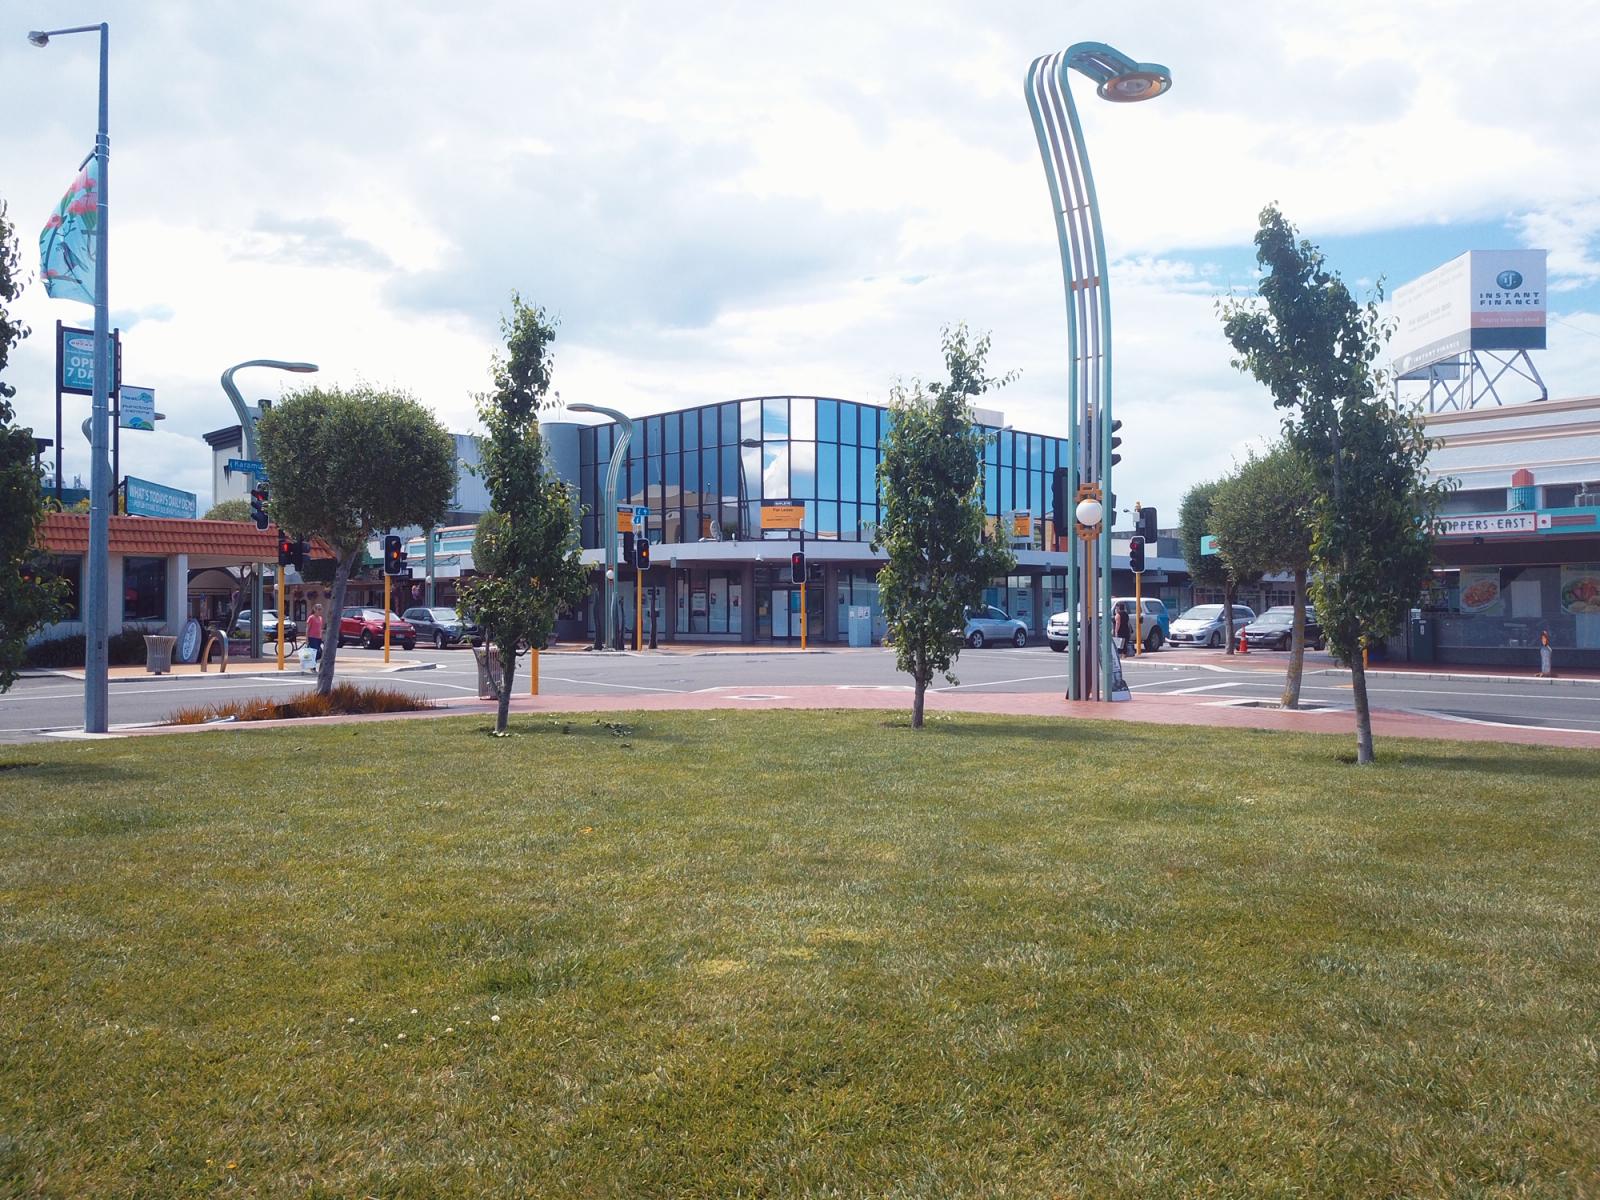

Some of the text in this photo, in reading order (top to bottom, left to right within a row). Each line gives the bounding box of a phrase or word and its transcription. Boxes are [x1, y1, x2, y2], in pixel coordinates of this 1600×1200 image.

[71, 356, 94, 368] OPE
[67, 367, 94, 379] 7 DA
[1445, 517, 1526, 532] OPPERS EAST
